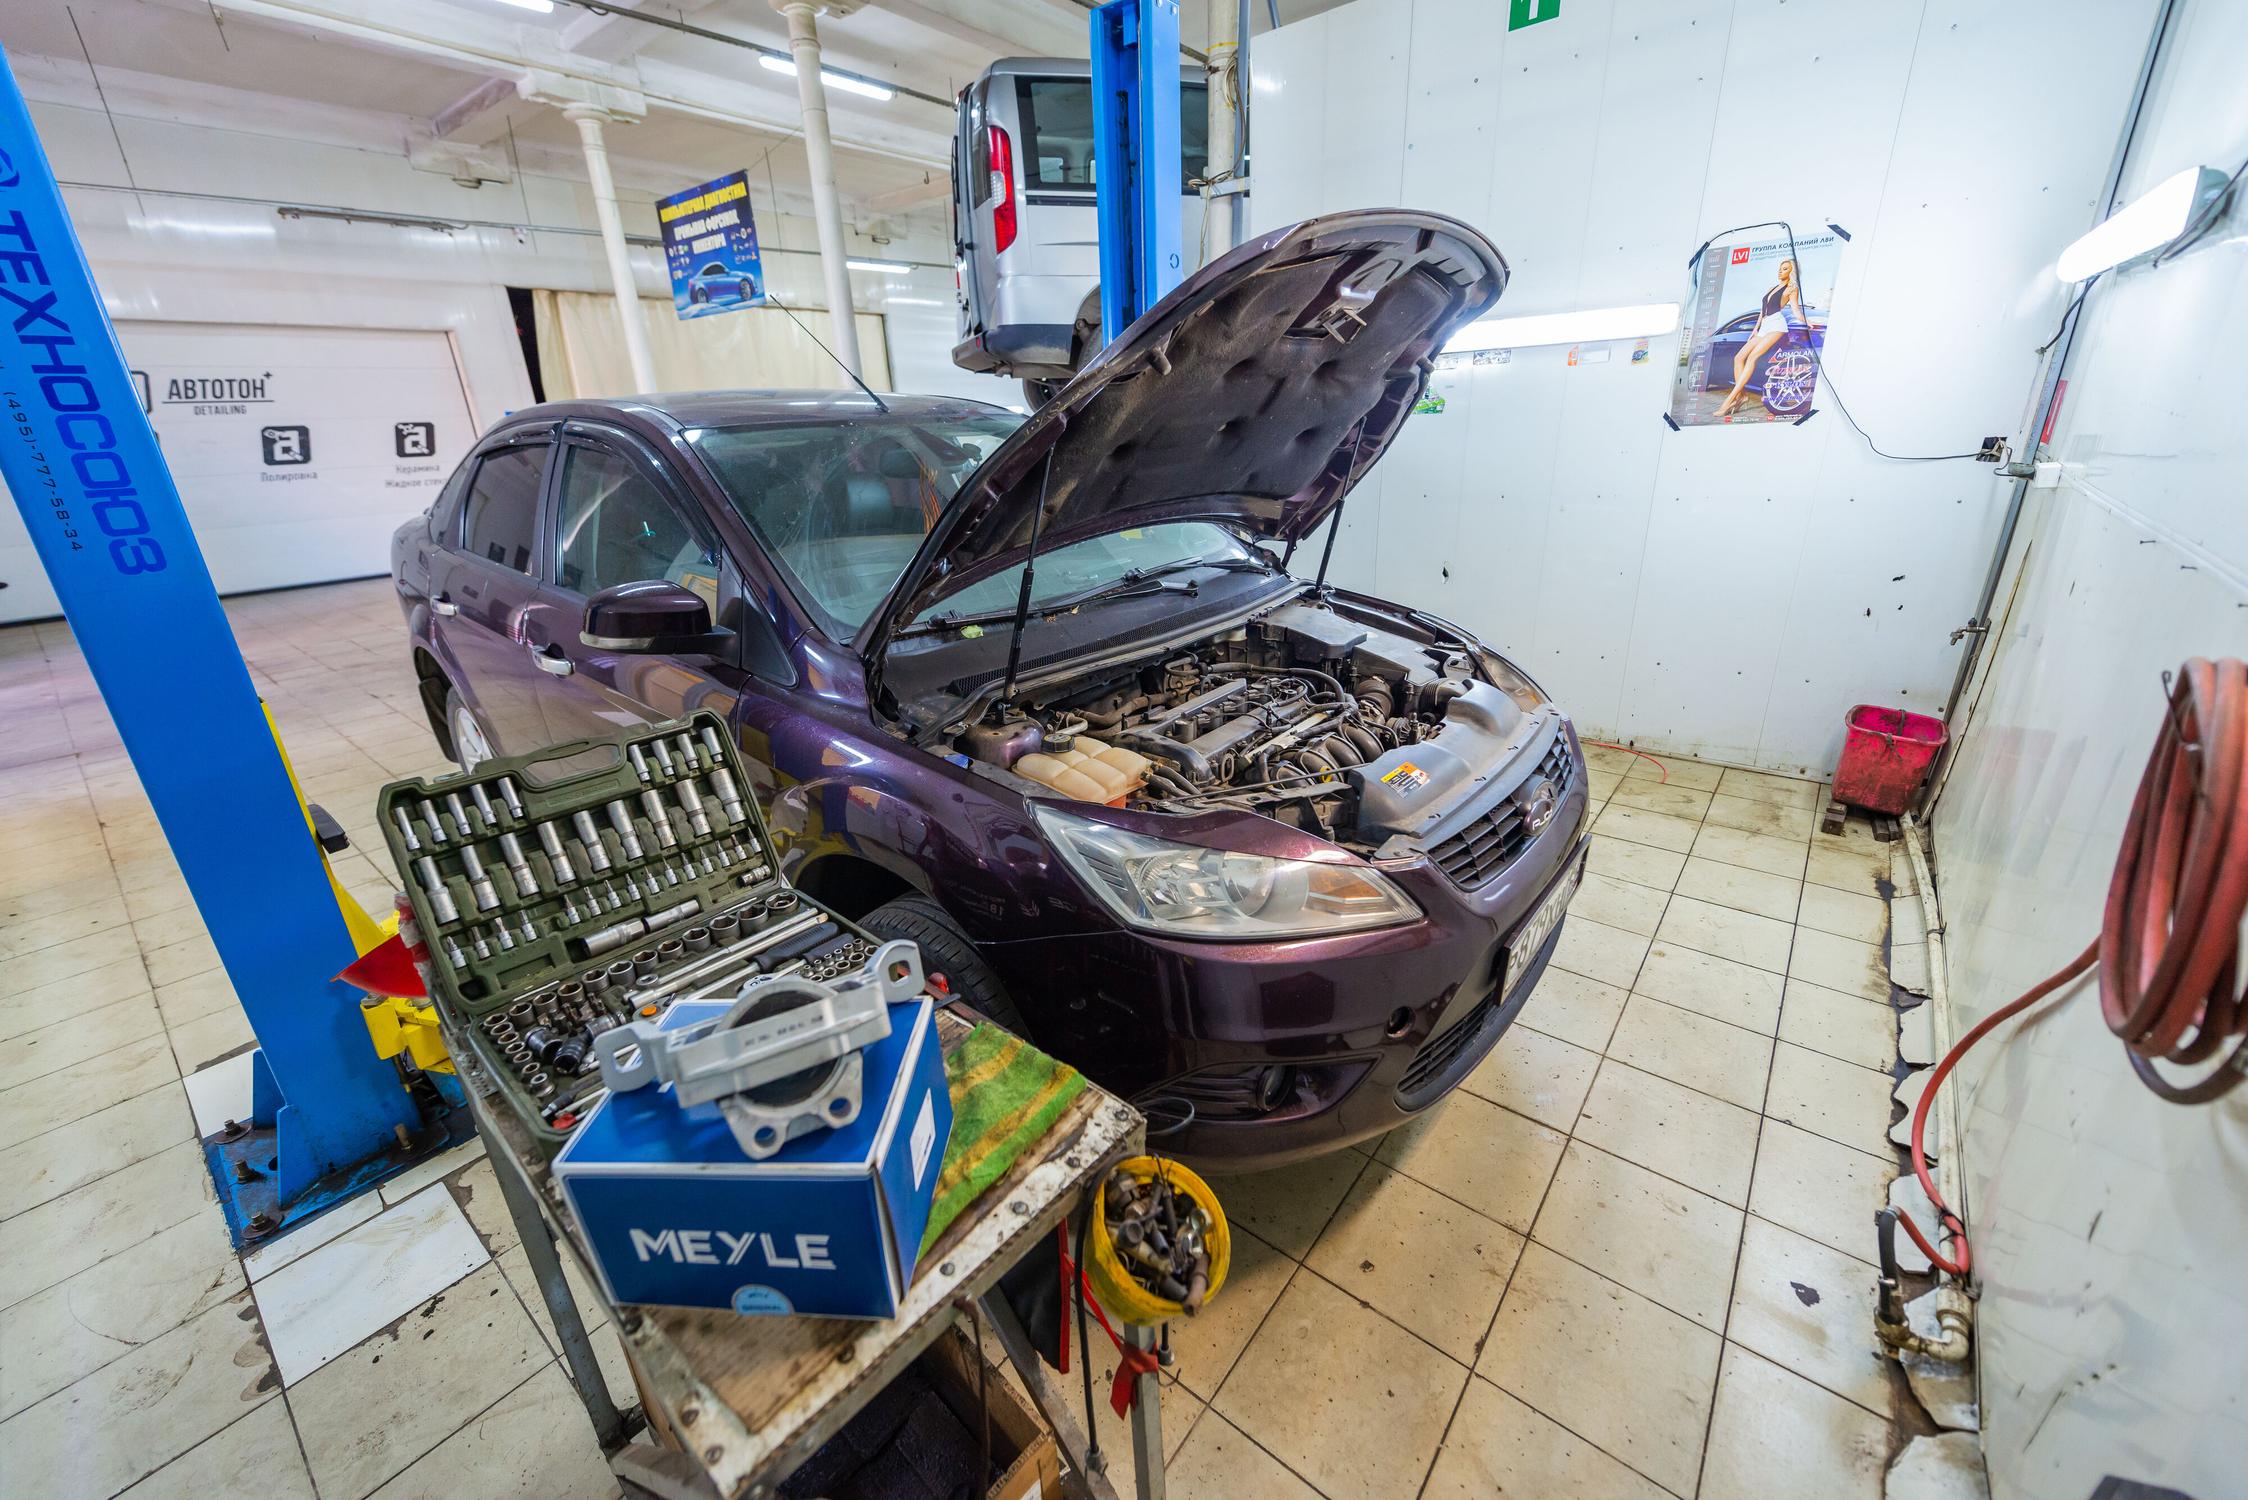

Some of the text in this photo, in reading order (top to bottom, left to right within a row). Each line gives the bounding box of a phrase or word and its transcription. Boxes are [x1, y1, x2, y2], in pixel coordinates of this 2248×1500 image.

[1752, 245, 1777, 253] ГРУППА
[1820, 236, 1834, 244] ЛВИ
[193, 405, 247, 416] DETAILING
[260, 471, 318, 482] Полировка
[630, 1229, 836, 1270] MEYLE
